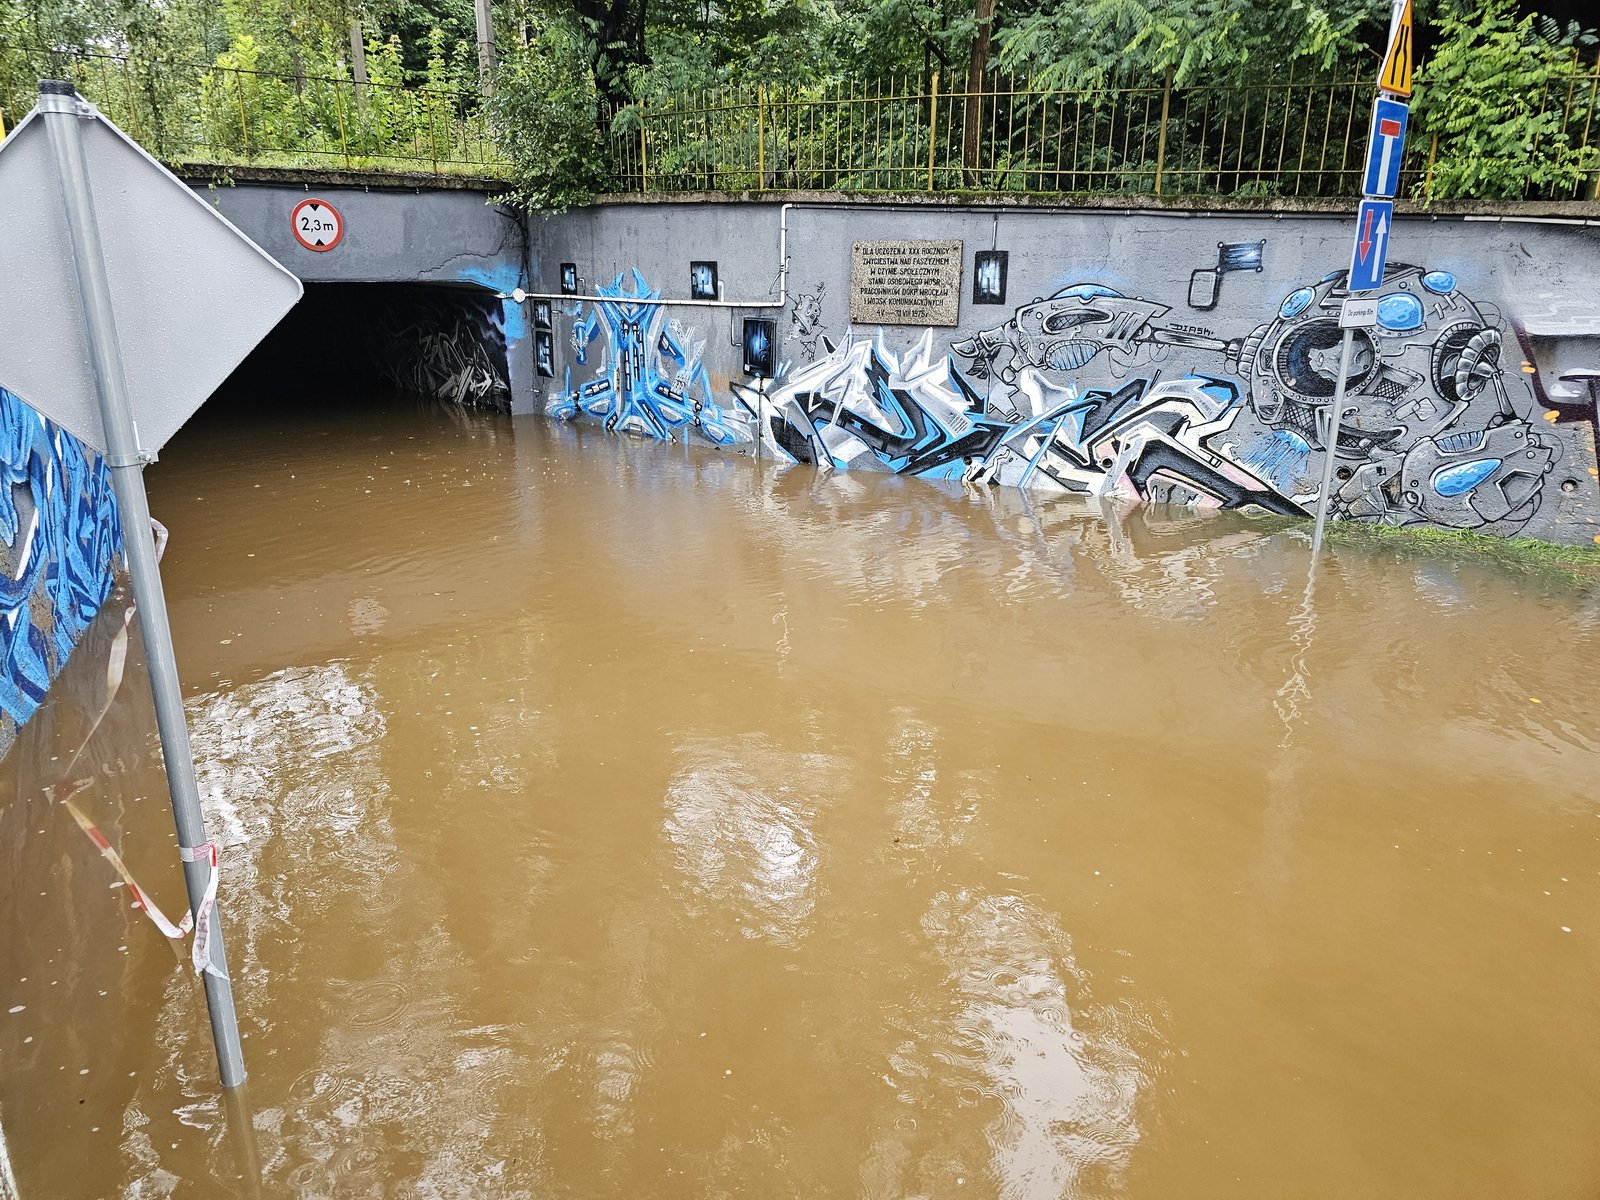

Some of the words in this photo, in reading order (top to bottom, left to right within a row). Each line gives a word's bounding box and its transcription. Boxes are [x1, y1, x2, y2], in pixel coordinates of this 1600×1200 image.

[301, 217, 321, 232] 2,3
[913, 258, 949, 266] FASZYZMEM
[888, 278, 923, 286] OSOBOWEGO
[889, 299, 944, 307] KOMUNIKACYJNYCH
